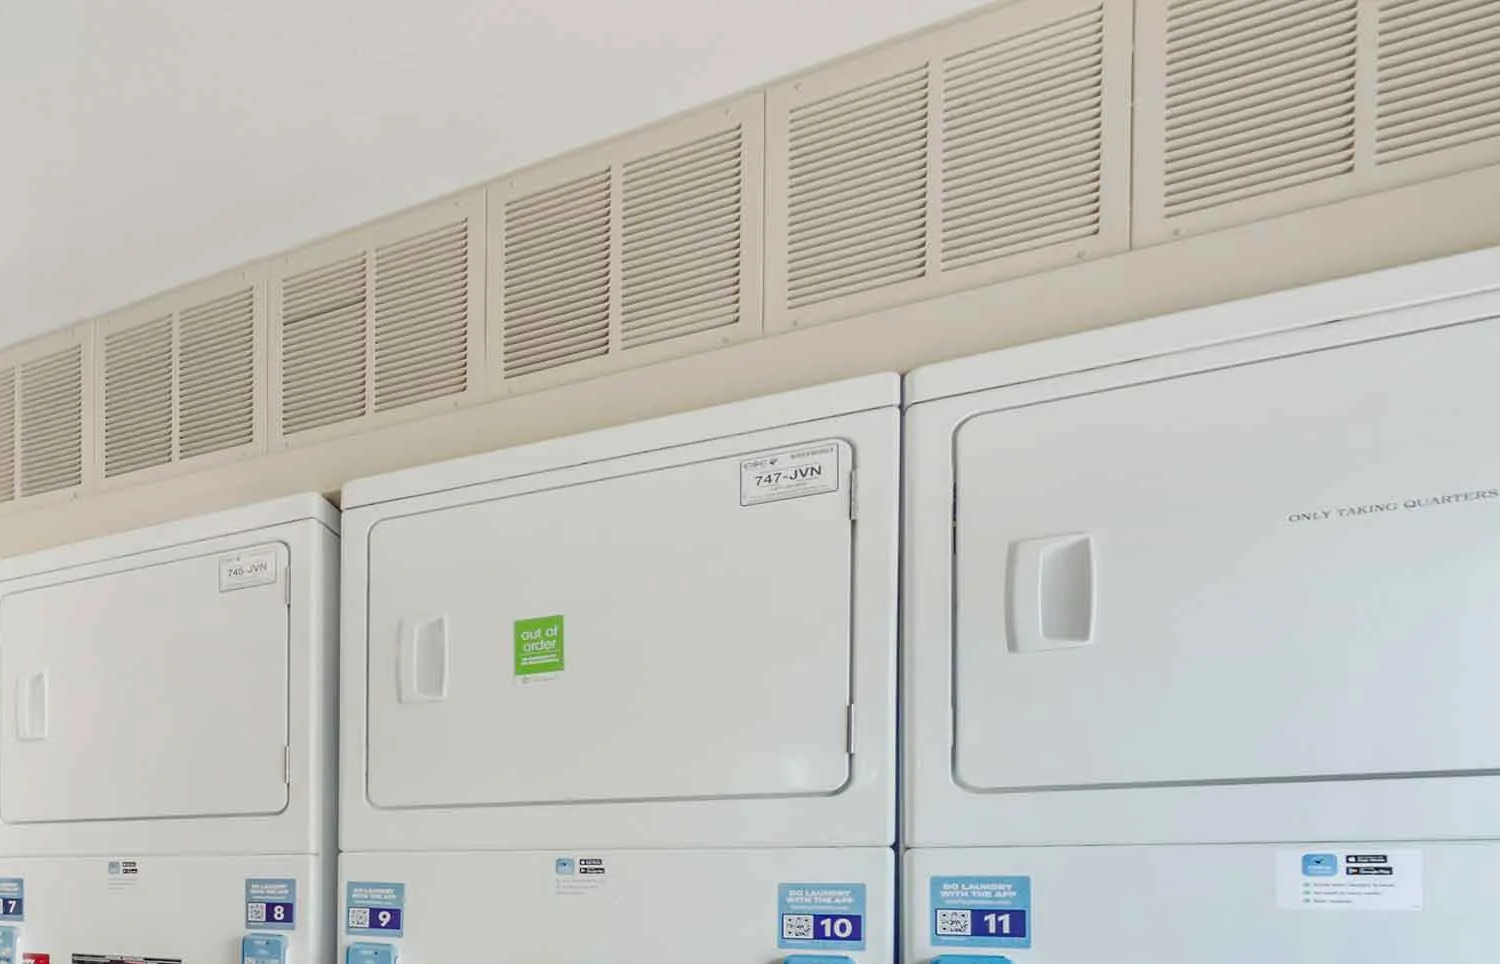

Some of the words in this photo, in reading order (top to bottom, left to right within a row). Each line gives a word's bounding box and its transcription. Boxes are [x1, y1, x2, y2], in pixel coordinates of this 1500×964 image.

[756, 465, 822, 487] 747-JVN
[1288, 510, 1331, 523] ONLY
[1337, 502, 1398, 518] TAKING
[1403, 488, 1499, 509] QUARTERS
[520, 628, 541, 641] out
[545, 624, 558, 637] of
[523, 639, 557, 652] order
[7, 900, 17, 913] 7
[273, 905, 285, 921] 8
[378, 910, 391, 927] 9
[984, 913, 1011, 934] 11
[820, 918, 853, 938] 10
